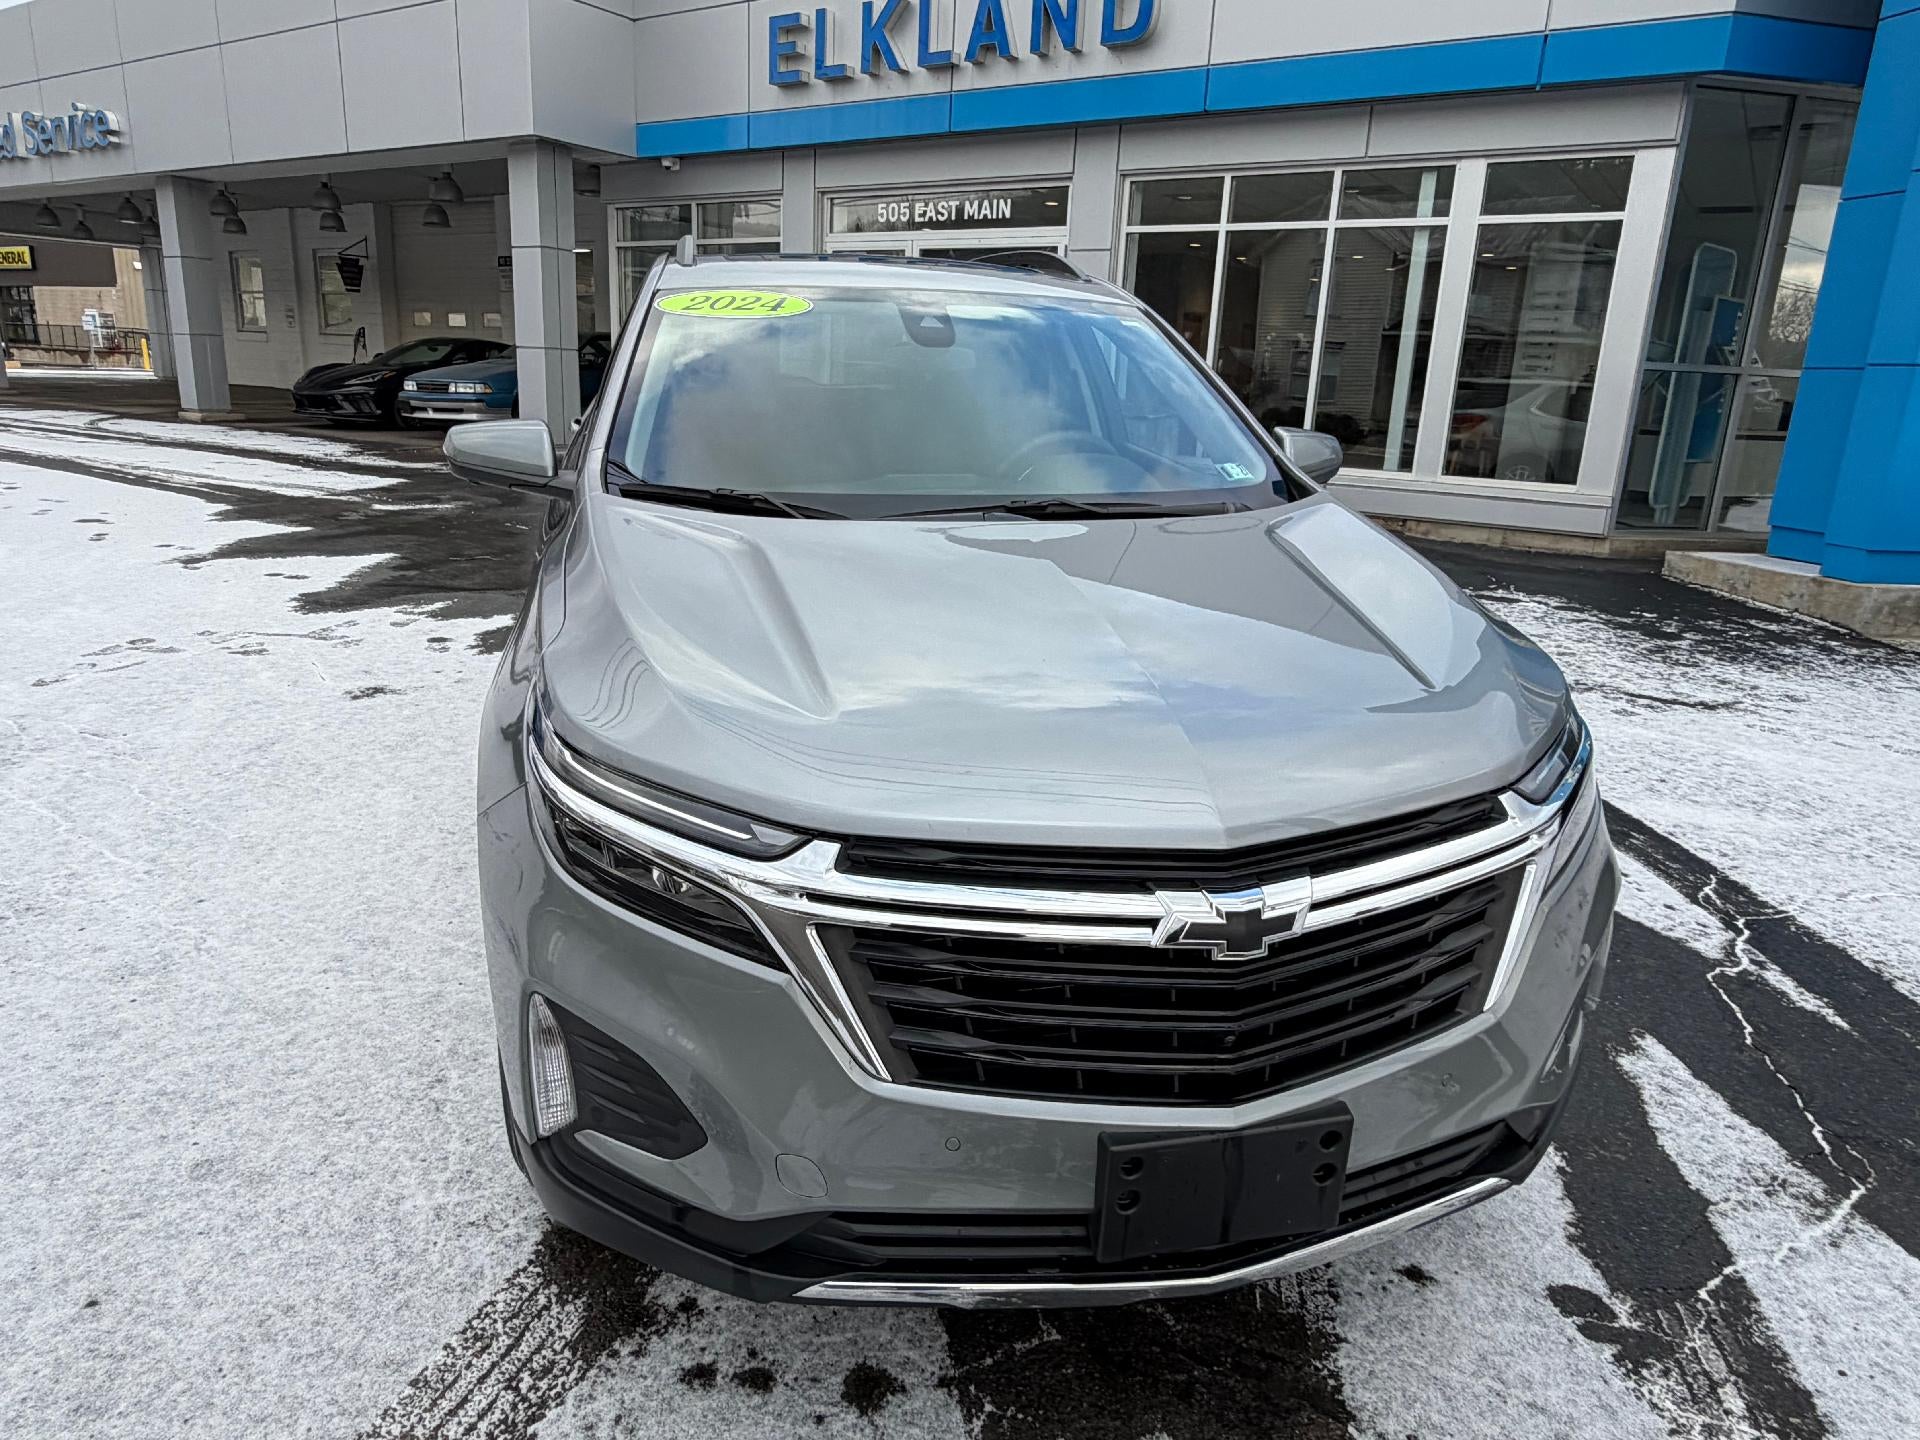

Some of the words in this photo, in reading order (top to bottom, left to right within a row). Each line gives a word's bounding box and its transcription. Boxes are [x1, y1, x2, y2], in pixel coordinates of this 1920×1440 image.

[769, 0, 1158, 86] ELKLAND
[22, 101, 119, 156] Service
[877, 202, 910, 222] 505
[914, 201, 960, 222] EAST
[963, 198, 1012, 220] MAIN
[682, 295, 785, 312] 2024
